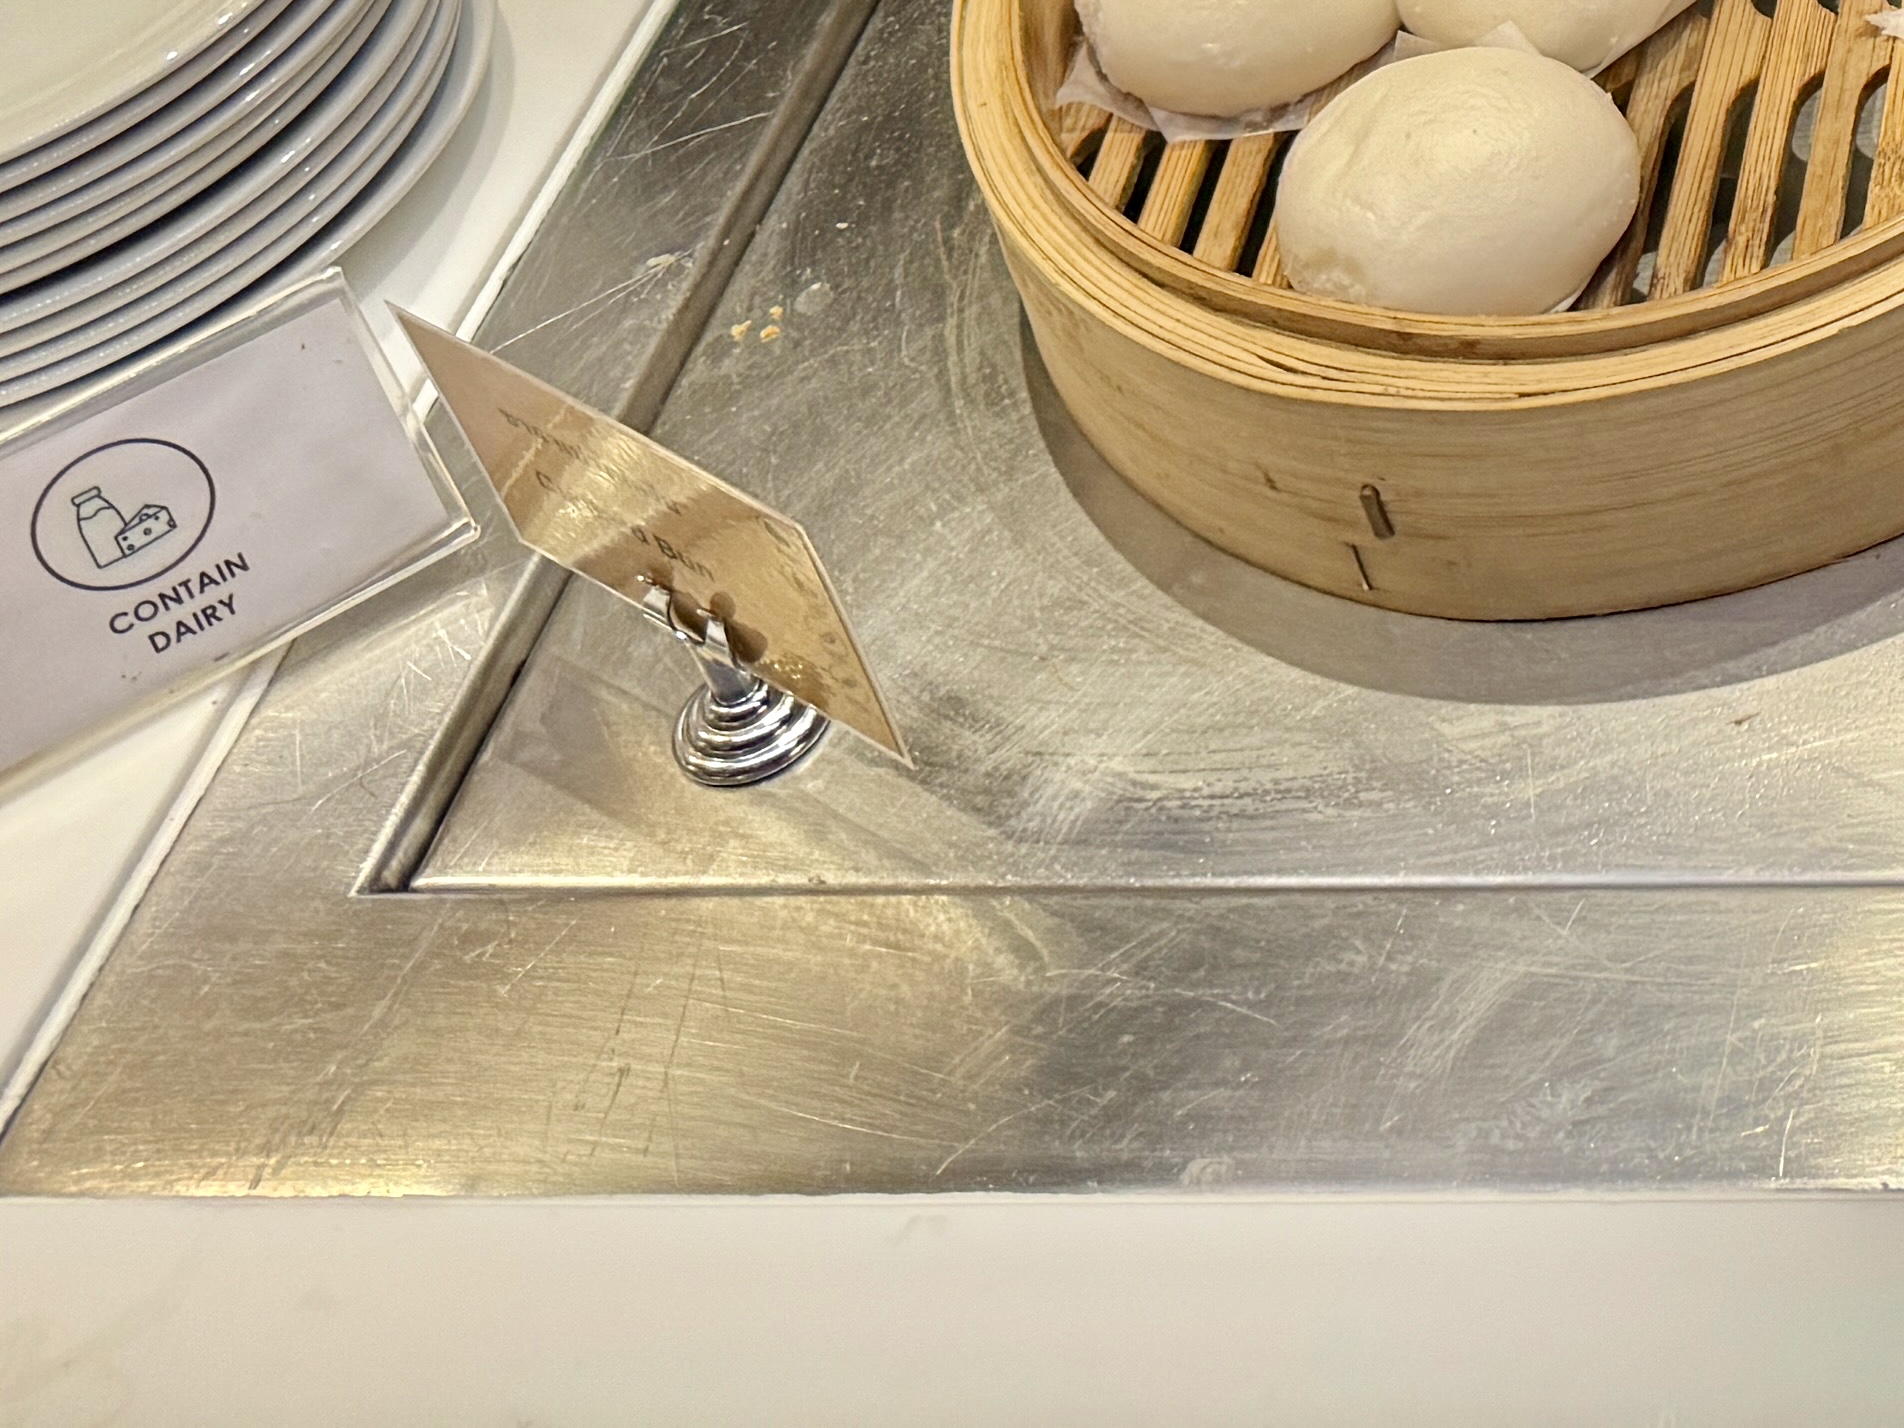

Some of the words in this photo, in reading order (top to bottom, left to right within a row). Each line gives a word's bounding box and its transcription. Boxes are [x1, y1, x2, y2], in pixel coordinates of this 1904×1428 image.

[652, 532, 716, 582] Bun
[108, 551, 250, 635] CONTAIN
[147, 592, 236, 654] DAIRY
